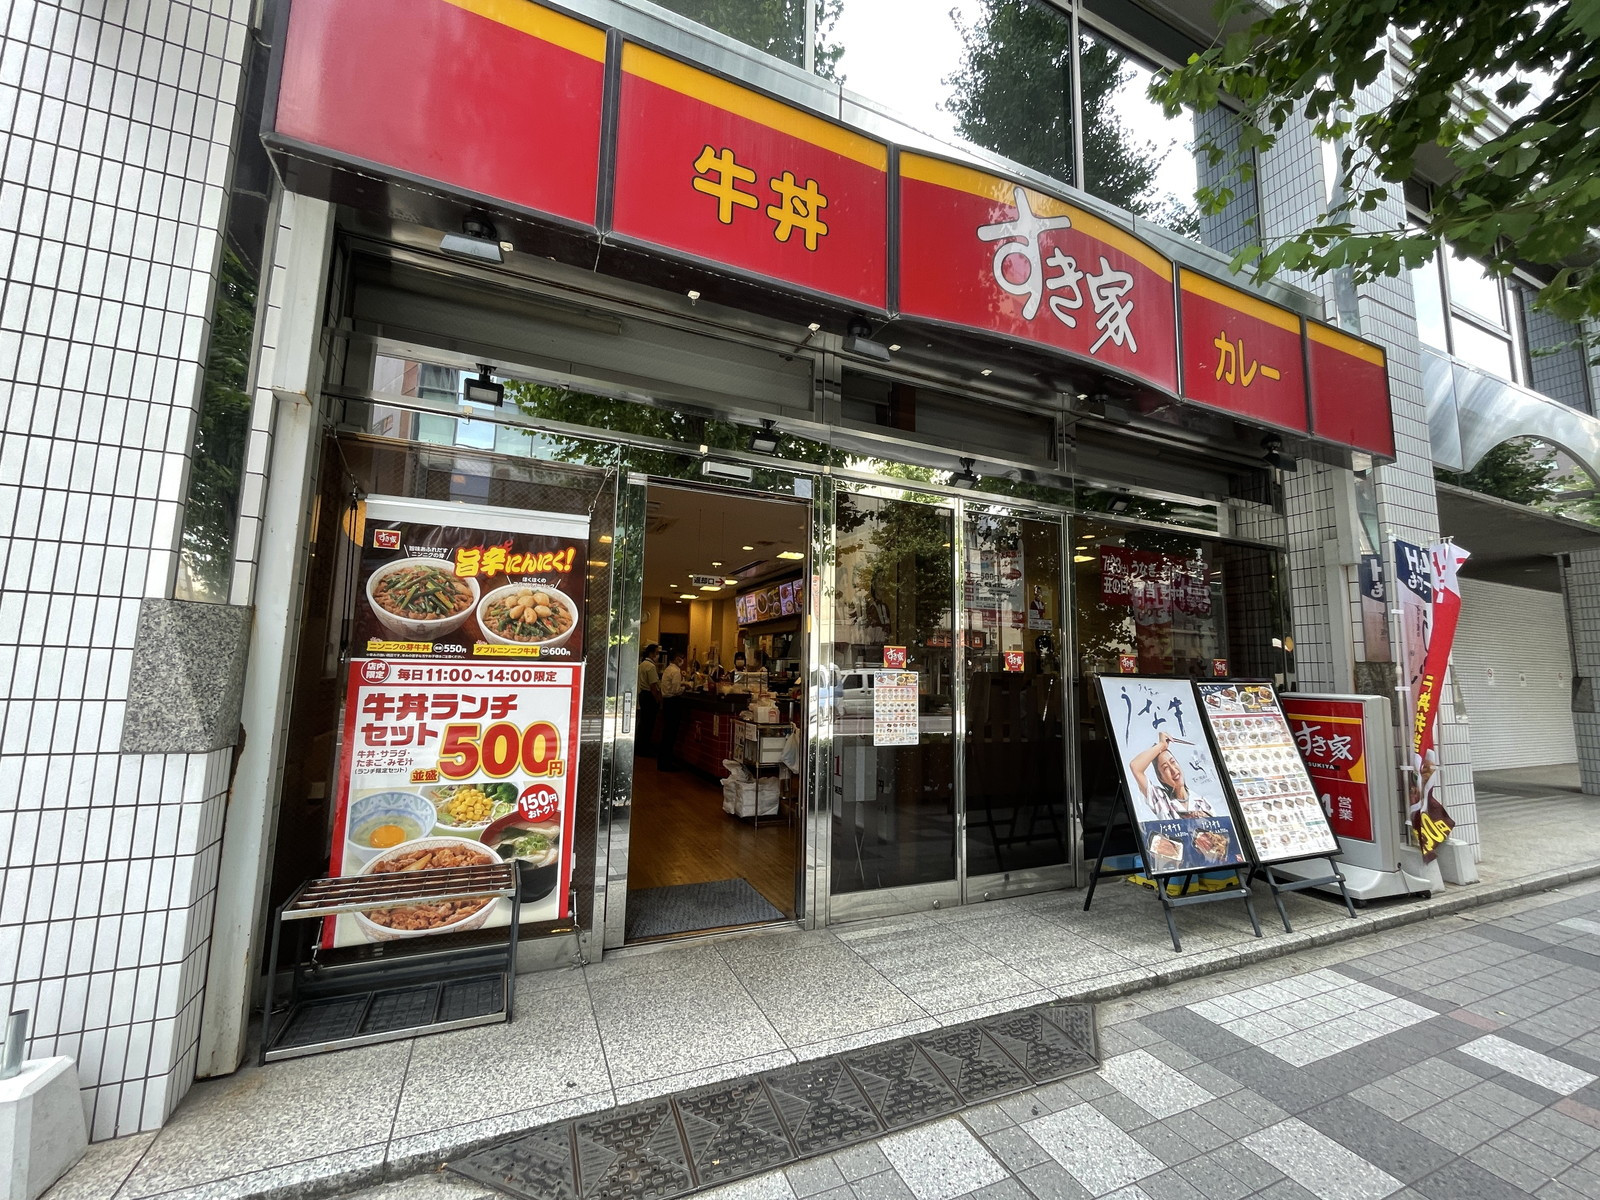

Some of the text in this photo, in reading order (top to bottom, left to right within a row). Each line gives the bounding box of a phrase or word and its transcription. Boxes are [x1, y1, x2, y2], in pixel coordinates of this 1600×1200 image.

[693, 145, 829, 251] 牛丼
[977, 186, 1138, 355] すき家
[1213, 330, 1281, 388] カレー
[475, 646, 538, 655] ダブルニンニク牛丼
[365, 670, 386, 680] 限定
[366, 662, 386, 671] 店内
[362, 693, 518, 721] 牛丼ランチ
[360, 722, 439, 746] セット
[1295, 721, 1353, 762] すき家
[438, 721, 564, 779] 500円
[411, 769, 439, 781] 並盛
[520, 790, 558, 811] 150円
[1337, 796, 1353, 821] 営業
